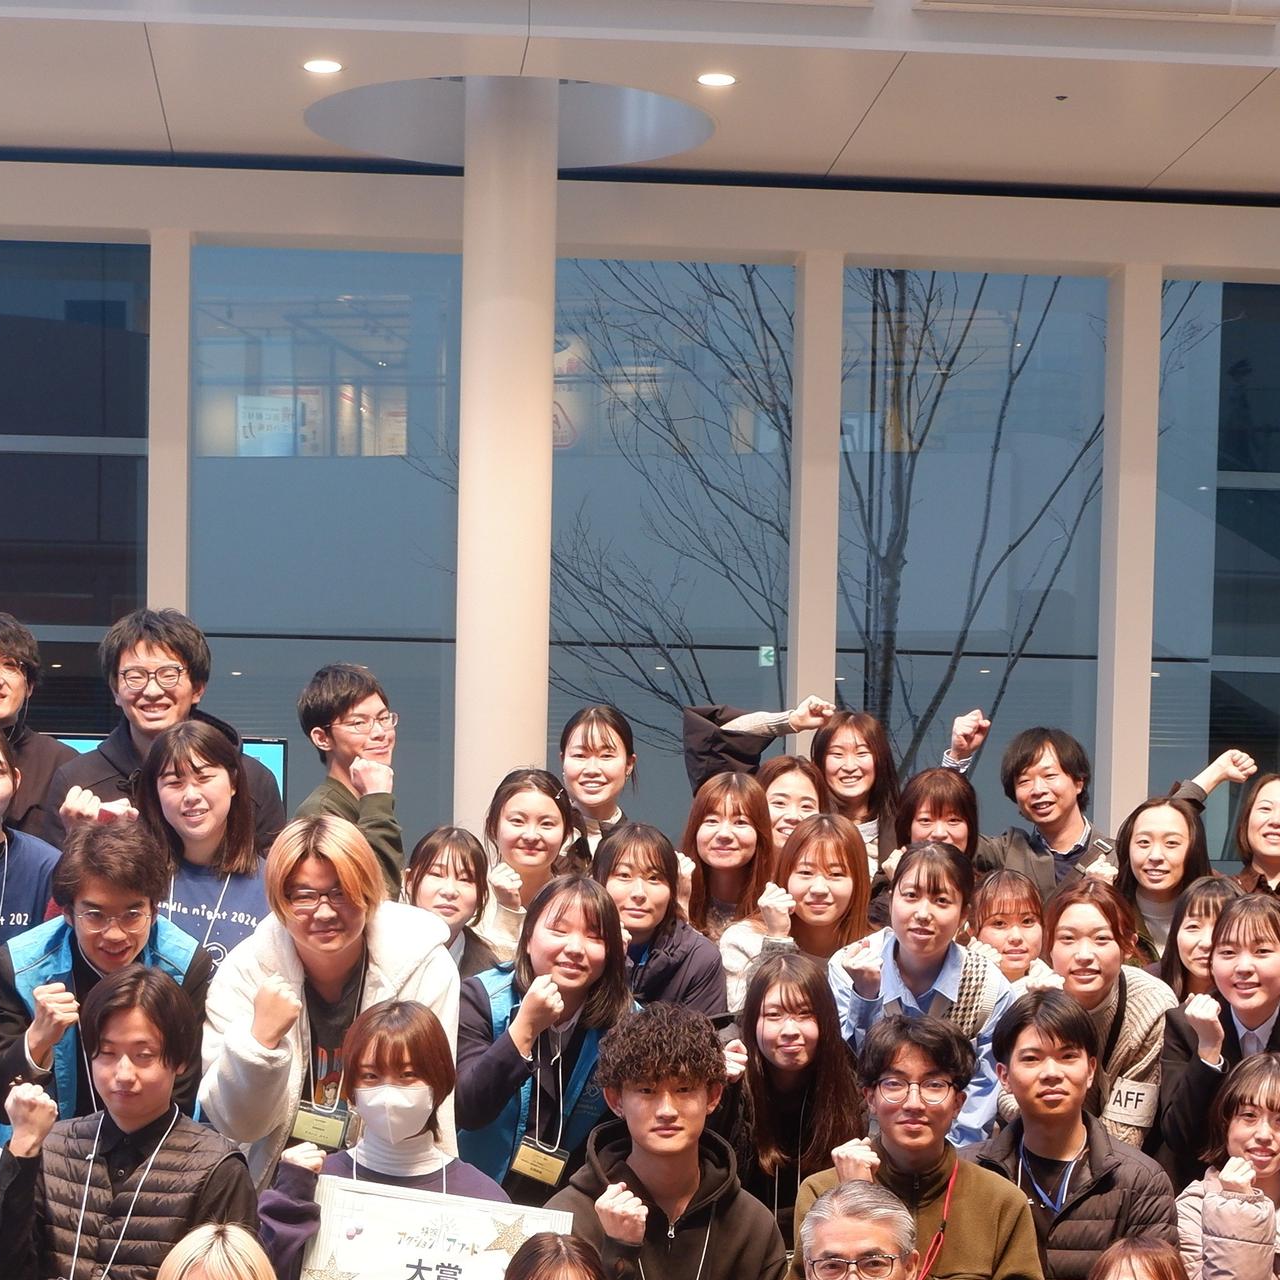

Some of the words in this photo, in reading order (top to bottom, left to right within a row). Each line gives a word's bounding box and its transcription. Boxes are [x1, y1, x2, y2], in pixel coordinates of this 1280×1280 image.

[9, 912, 30, 926] 202
[192, 904, 227, 921] night
[231, 912, 258, 928] 2024
[1111, 1089, 1145, 1109] AFF
